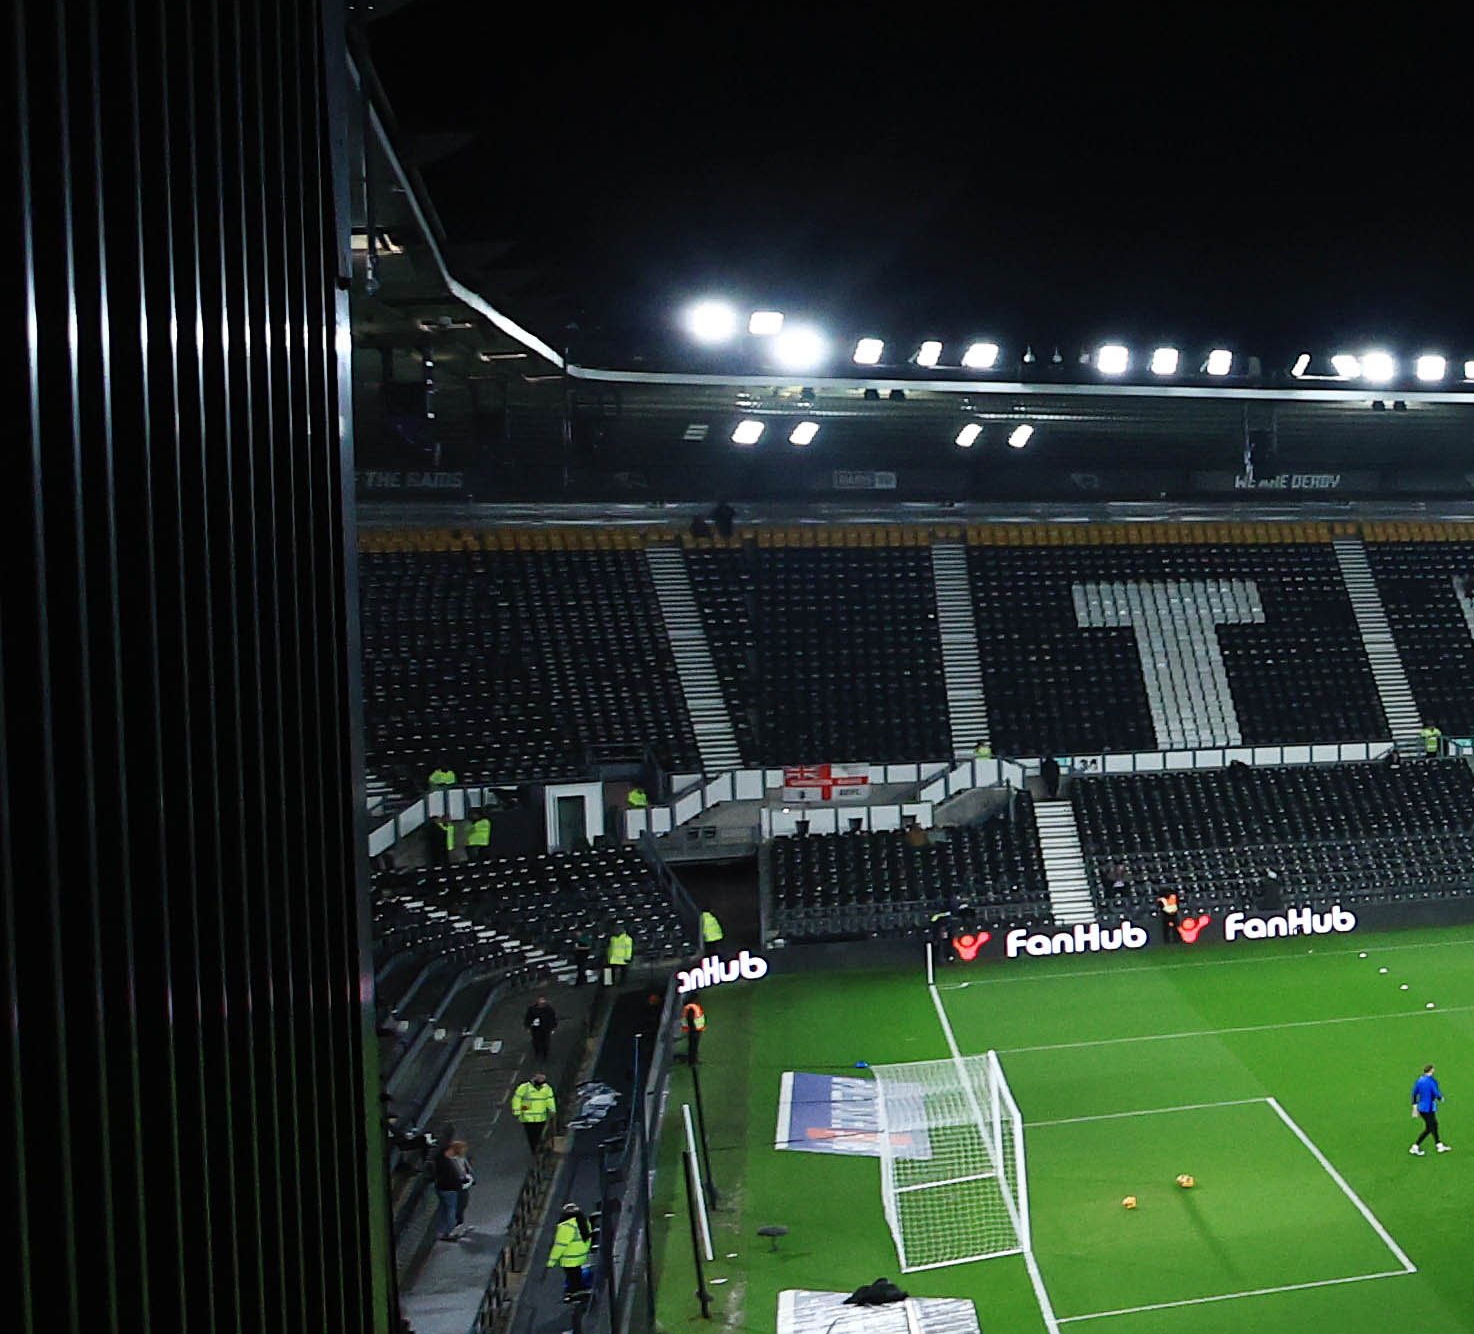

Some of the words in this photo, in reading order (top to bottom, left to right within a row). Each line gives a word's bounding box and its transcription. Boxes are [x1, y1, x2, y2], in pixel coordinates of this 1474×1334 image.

[1006, 914, 1148, 959] FanHub
[1225, 905, 1357, 942] FanHub
[678, 950, 769, 994] anHub
